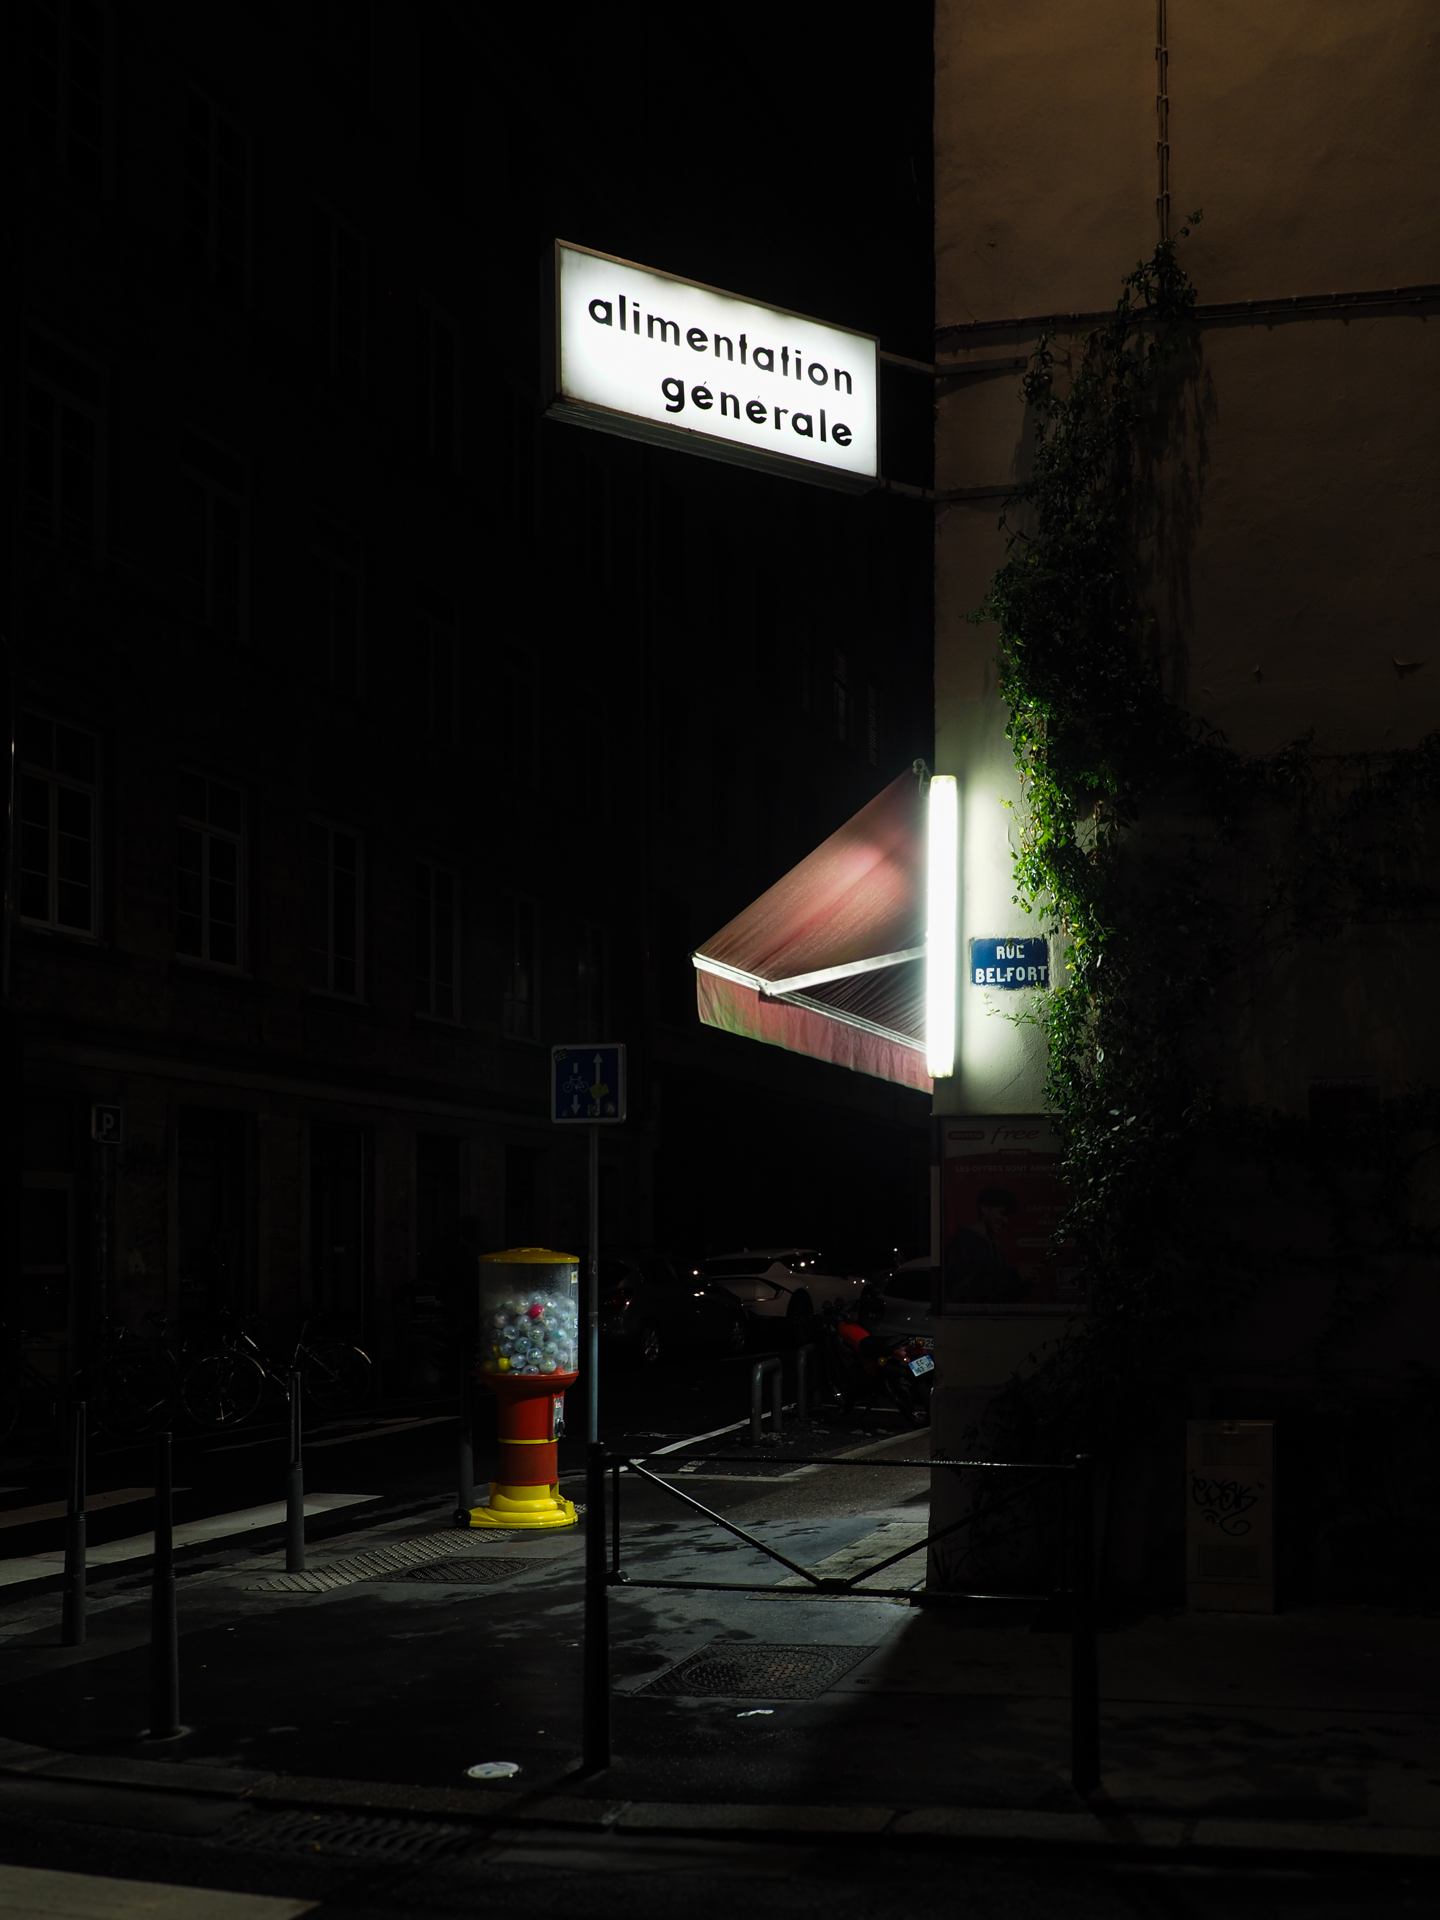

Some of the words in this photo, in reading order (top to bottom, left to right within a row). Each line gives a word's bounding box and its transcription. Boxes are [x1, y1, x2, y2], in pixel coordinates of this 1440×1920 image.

[588, 294, 852, 395] alimentation
[996, 944, 1025, 960] RUE
[975, 965, 1048, 984] BELFORT
[102, 1112, 115, 1135] P
[990, 1126, 1040, 1145] free
